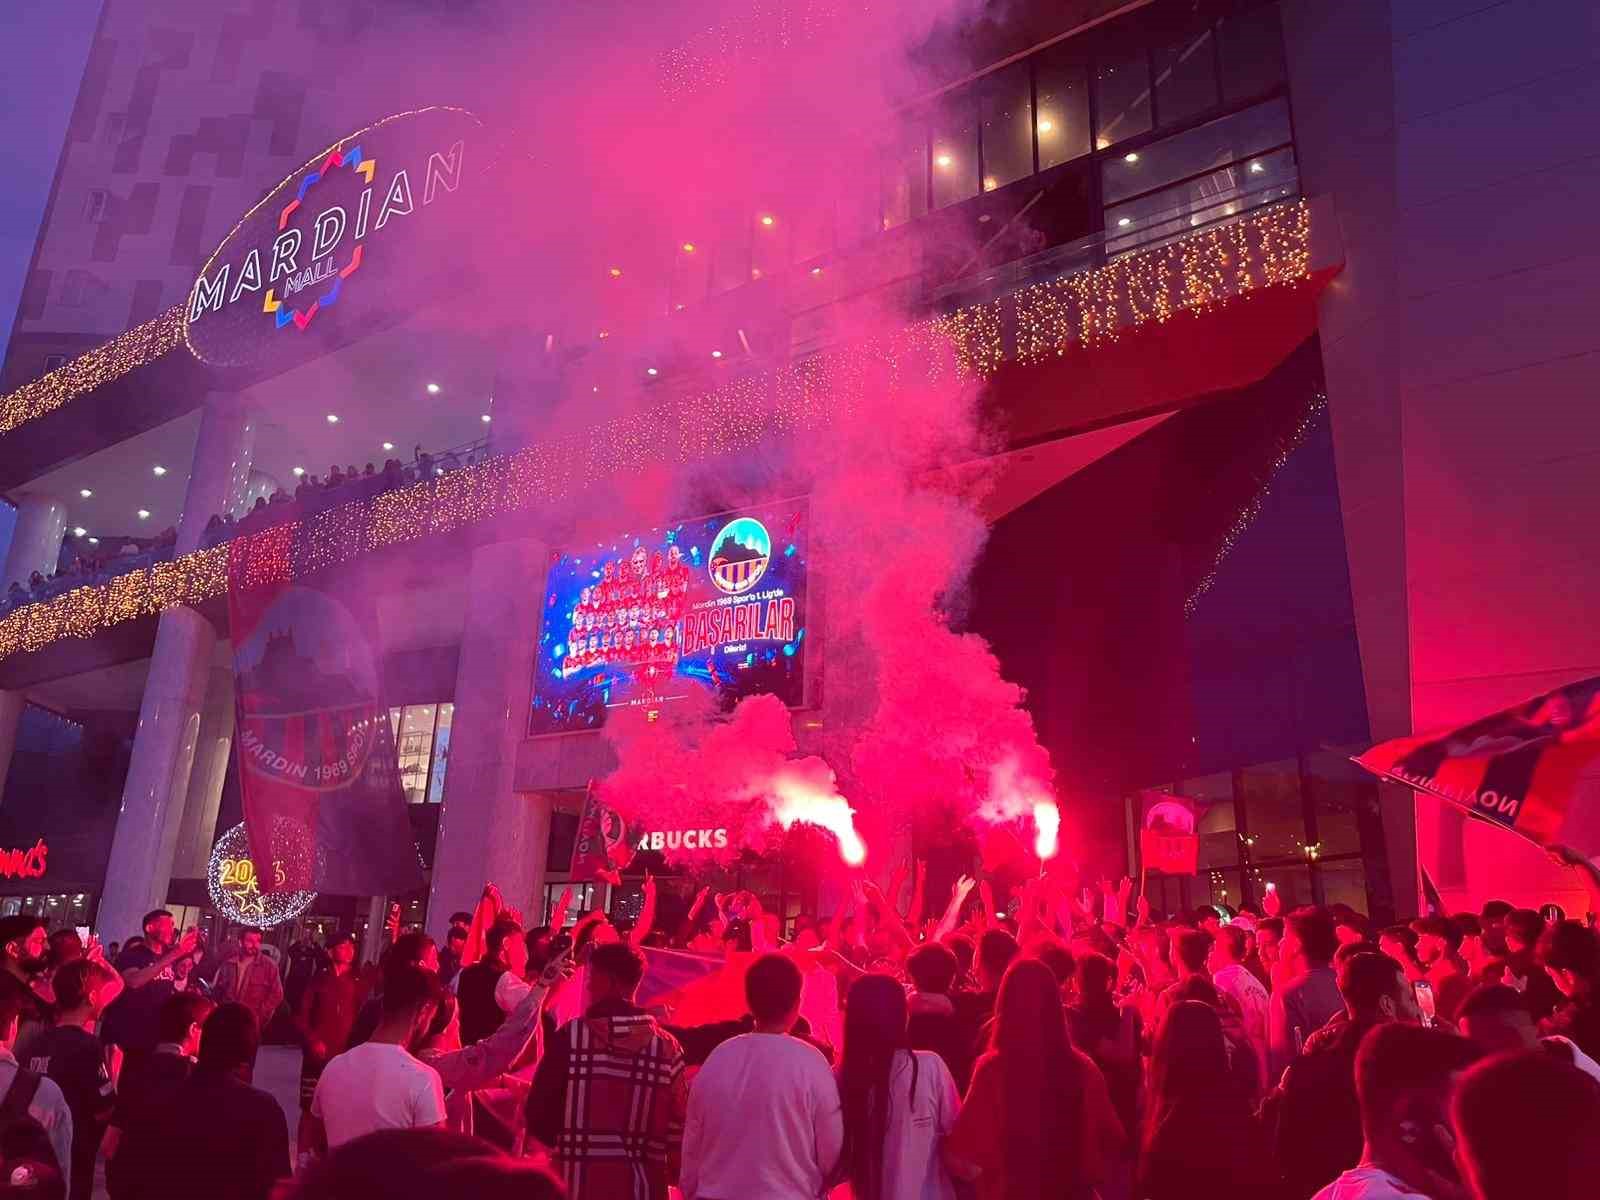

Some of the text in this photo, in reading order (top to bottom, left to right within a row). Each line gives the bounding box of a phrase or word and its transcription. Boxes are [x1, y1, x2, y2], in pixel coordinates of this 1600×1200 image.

[189, 140, 464, 322] MARDIAN
[284, 256, 338, 298] MALL
[682, 598, 795, 656] BAŞARILAR
[241, 730, 308, 778] MARDIN
[637, 828, 728, 850] RBUCKS
[220, 859, 286, 886] 203
